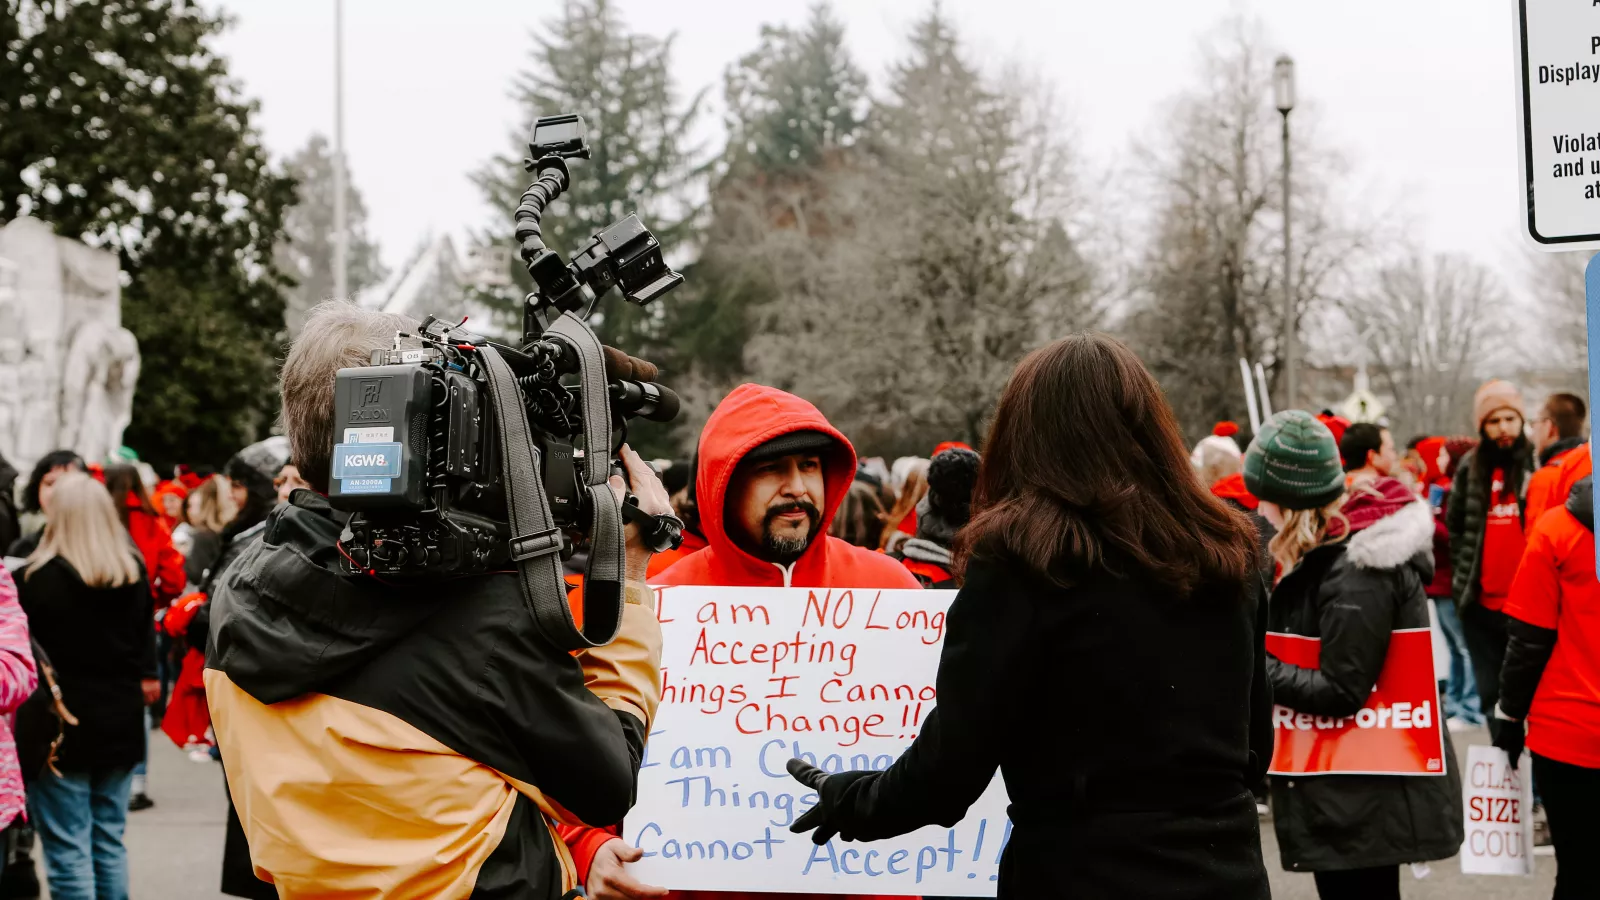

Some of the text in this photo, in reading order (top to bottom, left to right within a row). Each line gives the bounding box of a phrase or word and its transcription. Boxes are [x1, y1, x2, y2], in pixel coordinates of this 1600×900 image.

[1538, 62, 1600, 85] Display
[1553, 158, 1584, 177] and
[345, 455, 385, 467] KGW8
[653, 584, 945, 645] I am NO Long
[690, 627, 857, 677] Accepting
[660, 667, 936, 714] hings I Canno
[735, 702, 922, 746] Change!!
[669, 745, 732, 769] am
[758, 738, 908, 779] Chan
[664, 775, 820, 827] Things
[1469, 796, 1520, 824] SIZE
[635, 821, 785, 860] Cannot
[1469, 829, 1525, 858] COU
